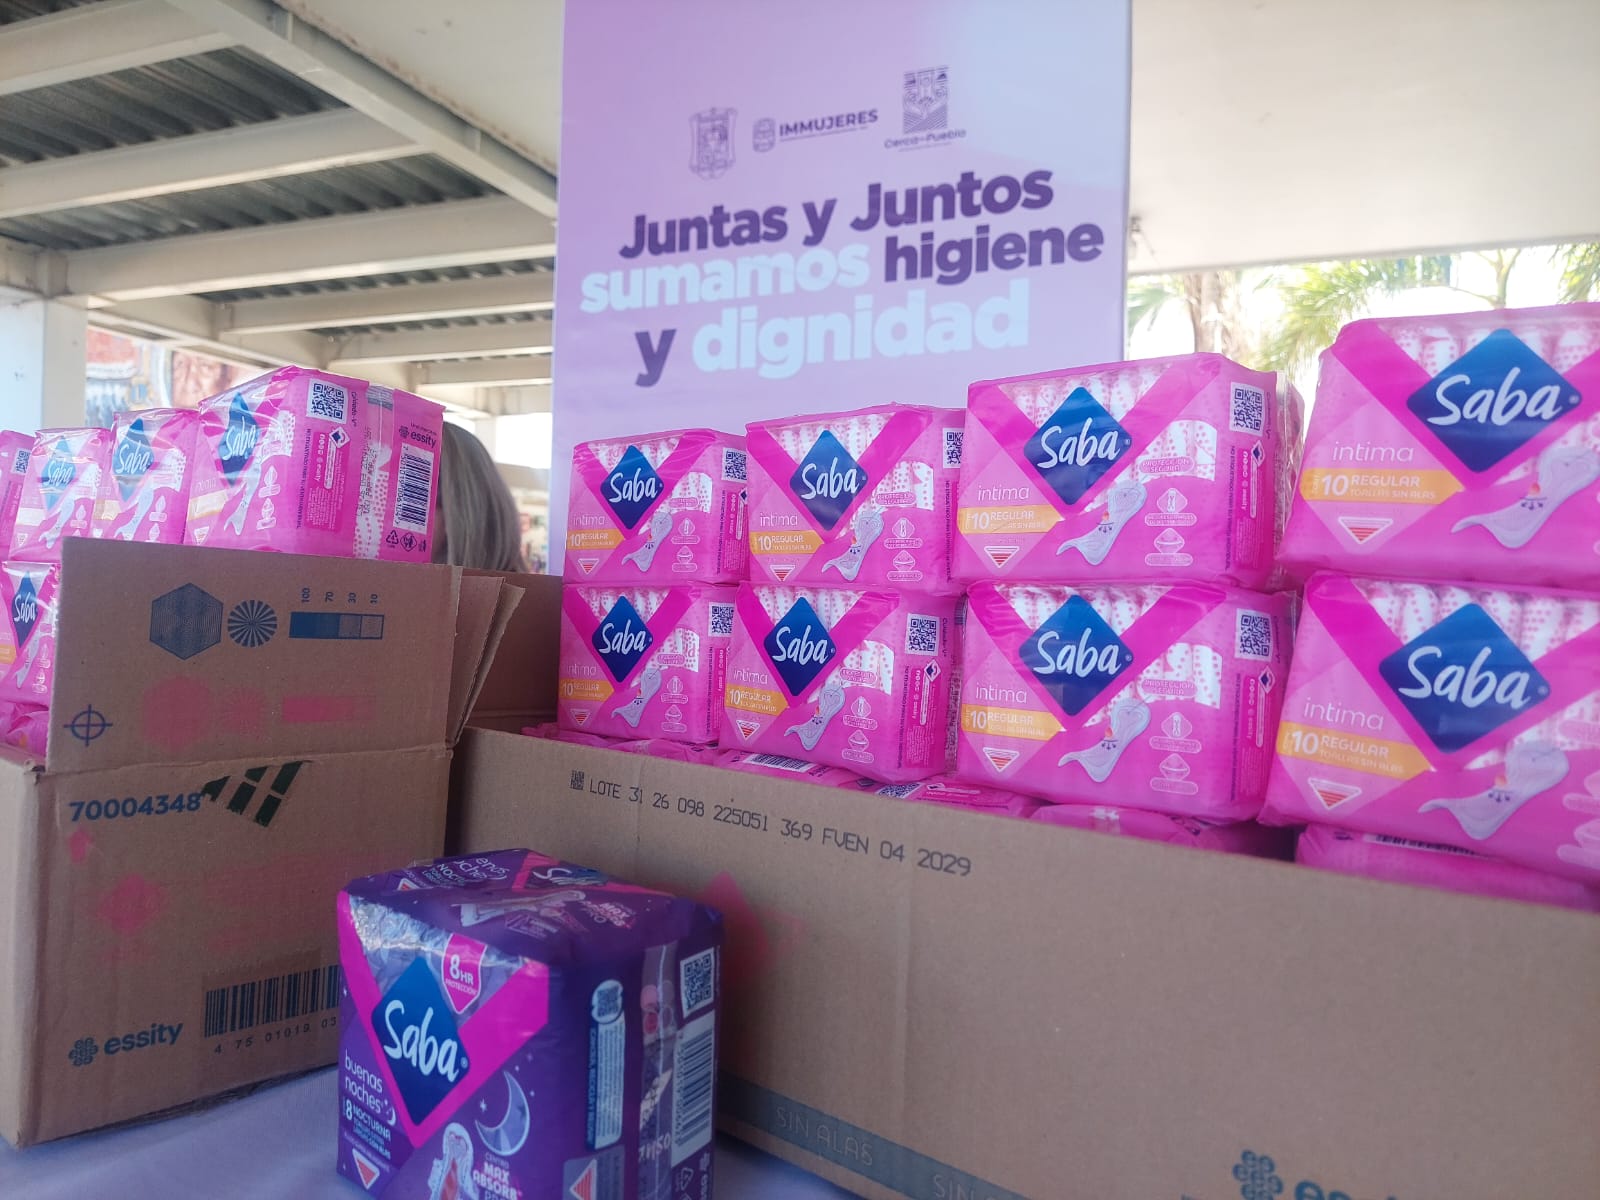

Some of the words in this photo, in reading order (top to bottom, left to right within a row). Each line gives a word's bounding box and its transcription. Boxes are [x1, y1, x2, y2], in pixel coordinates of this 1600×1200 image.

[779, 109, 878, 137] IMMUJERES
[619, 206, 787, 258] Juntas
[802, 199, 837, 246] y
[850, 169, 1054, 232] Juntos
[580, 244, 870, 313] sumamos
[884, 223, 1104, 284] higiene
[635, 328, 676, 388] y
[692, 278, 1030, 379] dignidad
[1426, 367, 1563, 426] Saba
[223, 416, 257, 460] Saba
[410, 431, 437, 449] essity
[1037, 418, 1121, 469] Saba
[1333, 441, 1414, 462] intima
[48, 461, 74, 486] Saba
[116, 441, 150, 474] Saba
[609, 467, 658, 504] Saba
[801, 457, 859, 500] Saba
[978, 484, 1030, 501] intima
[1322, 474, 1349, 497] 10
[1351, 474, 1421, 487] REGULAR
[760, 513, 798, 527] intima
[971, 512, 989, 529] 10
[991, 510, 1034, 521] REGULAR
[570, 535, 581, 547] 10
[758, 536, 772, 551] 10
[14, 592, 36, 623] Saba
[301, 587, 311, 603] 100
[598, 618, 647, 656] Saba
[772, 625, 829, 664] Saba
[1033, 628, 1121, 678] Saba
[562, 683, 574, 697] 10
[734, 667, 768, 685] intima
[1398, 646, 1532, 709] Saba
[729, 690, 741, 705] 10
[976, 682, 1027, 703] intima
[971, 710, 987, 729] 10
[988, 711, 1033, 726] REGULAR
[1304, 697, 1384, 731] intima
[1292, 731, 1319, 755] 10
[1321, 735, 1389, 758] REGULAR
[69, 792, 201, 822] 70004348
[589, 778, 621, 800] LOTE
[629, 787, 643, 805] 31
[652, 792, 670, 811] 26
[678, 798, 705, 817] 098
[713, 805, 769, 832] 225051
[780, 819, 813, 841] 369
[823, 828, 869, 855] FVEN
[880, 841, 905, 862] 04
[918, 849, 971, 876] 2029
[104, 1023, 184, 1056] essity
[383, 1000, 458, 1083] Saba
[345, 1048, 383, 1093] buenas
[345, 1076, 381, 1113] noches
[346, 1099, 353, 1120] 8
[353, 1103, 391, 1141] NOCTURNA
[776, 1106, 809, 1138] SIN
[816, 1124, 872, 1166] ALAS
[473, 1170, 518, 1200] ABSORB
[484, 1162, 510, 1185] MAX
